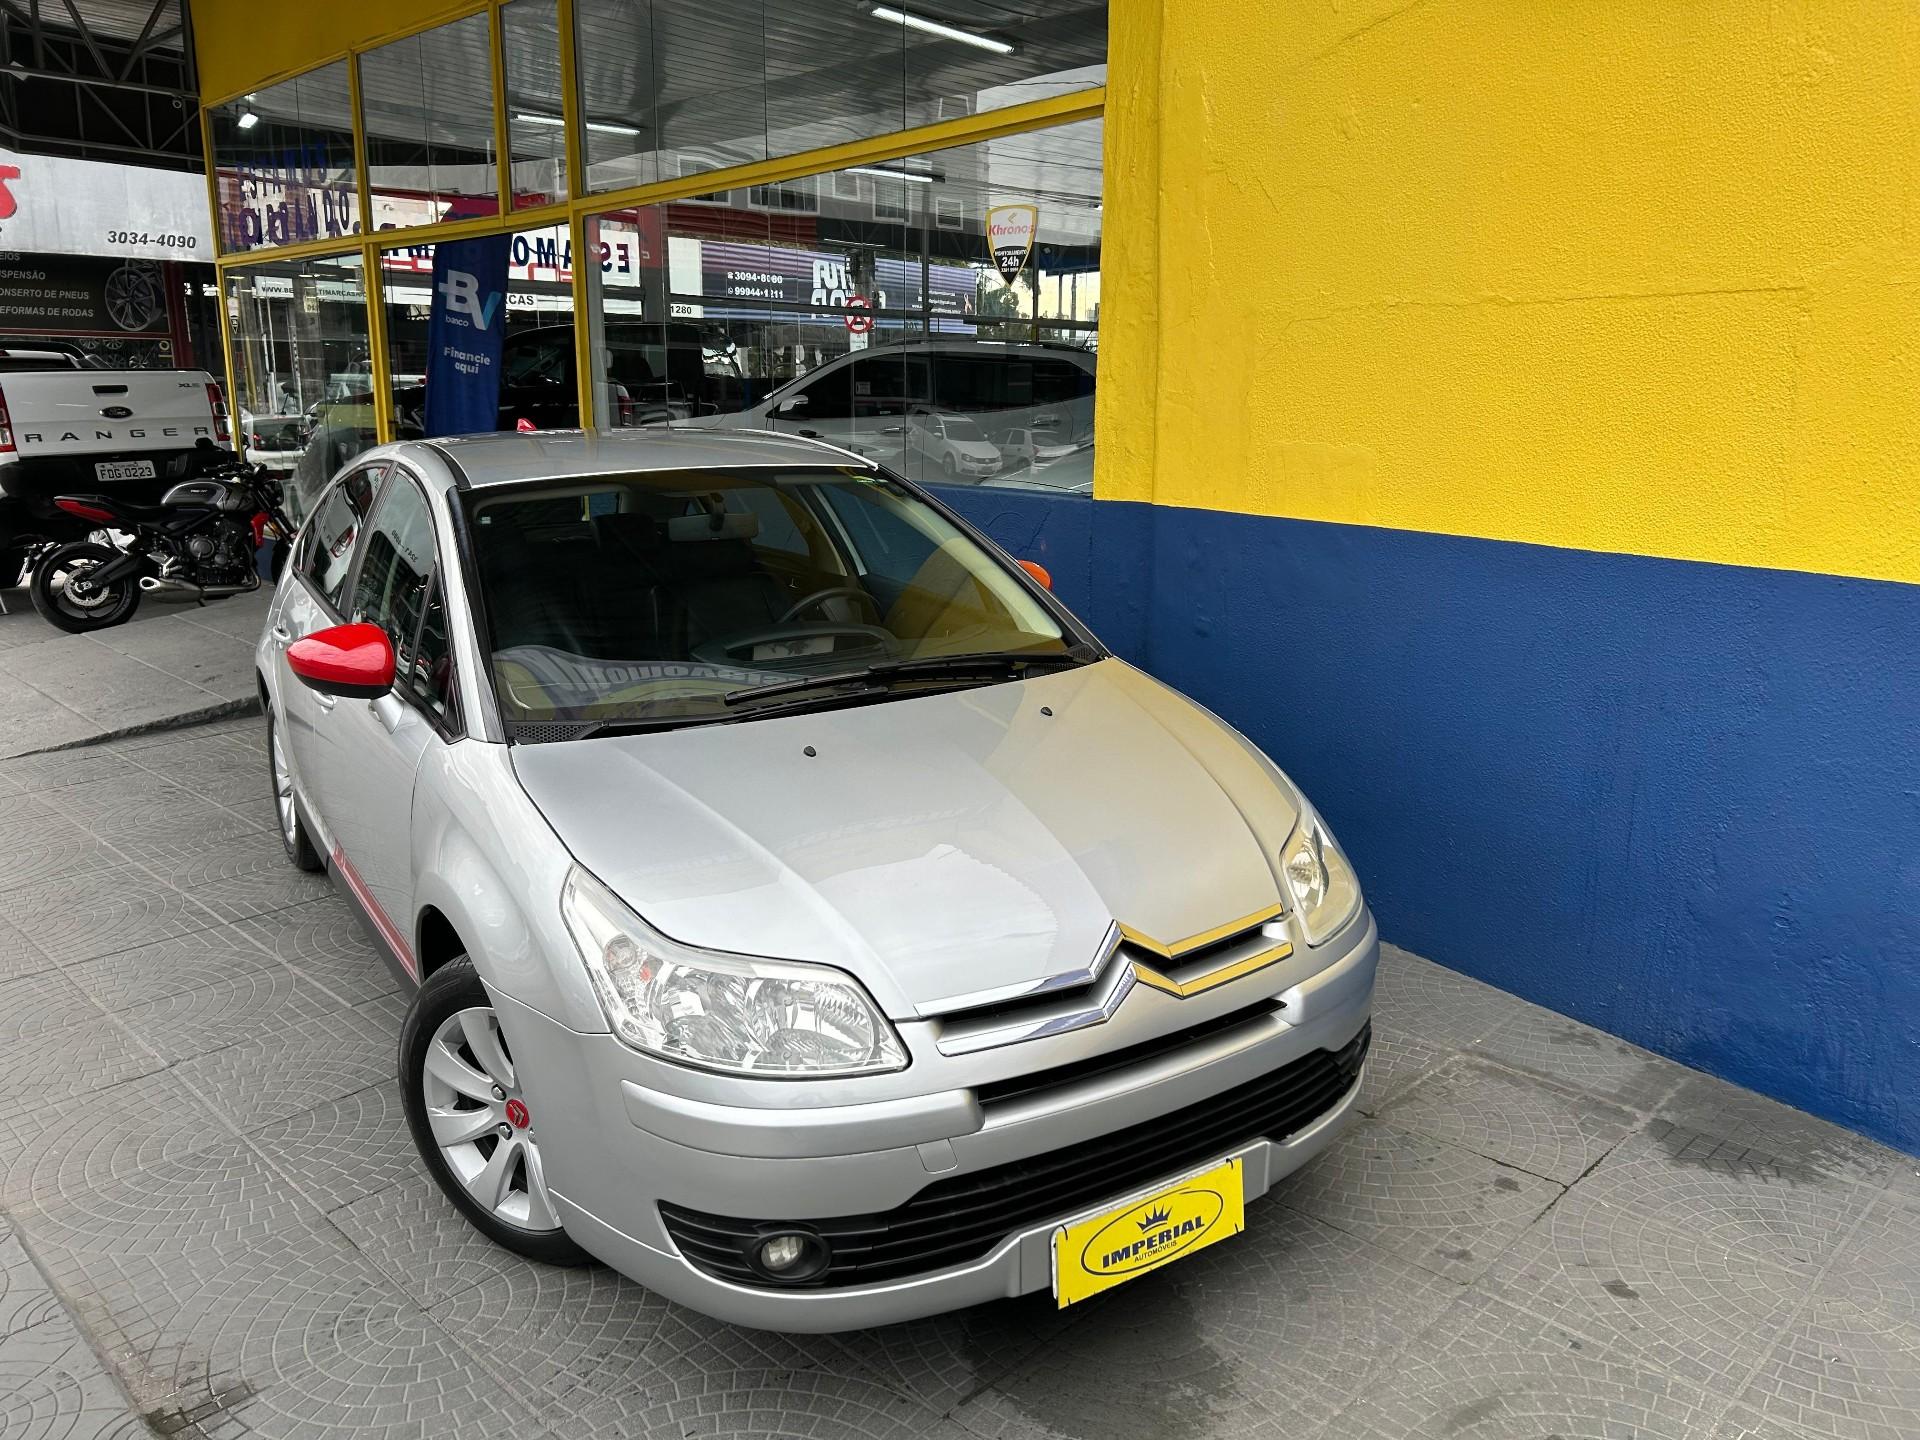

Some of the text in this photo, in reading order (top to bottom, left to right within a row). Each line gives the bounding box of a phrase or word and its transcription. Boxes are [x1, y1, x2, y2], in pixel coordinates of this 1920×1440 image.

[989, 223, 1035, 236] Khronos
[107, 231, 197, 249] 3034-4090
[1001, 256, 1019, 267] 24h
[44, 289, 57, 298] DE
[58, 290, 89, 300] PNEUS
[47, 307, 60, 316] DE
[62, 308, 94, 317] RODAS
[445, 315, 469, 327] banco
[443, 346, 491, 366] Financie
[454, 361, 479, 374] aqui
[24, 427, 209, 443] RANGER
[1102, 1216, 1205, 1269] IMPERIAL
[1134, 1240, 1177, 1263] AUTOMÓVEIS
